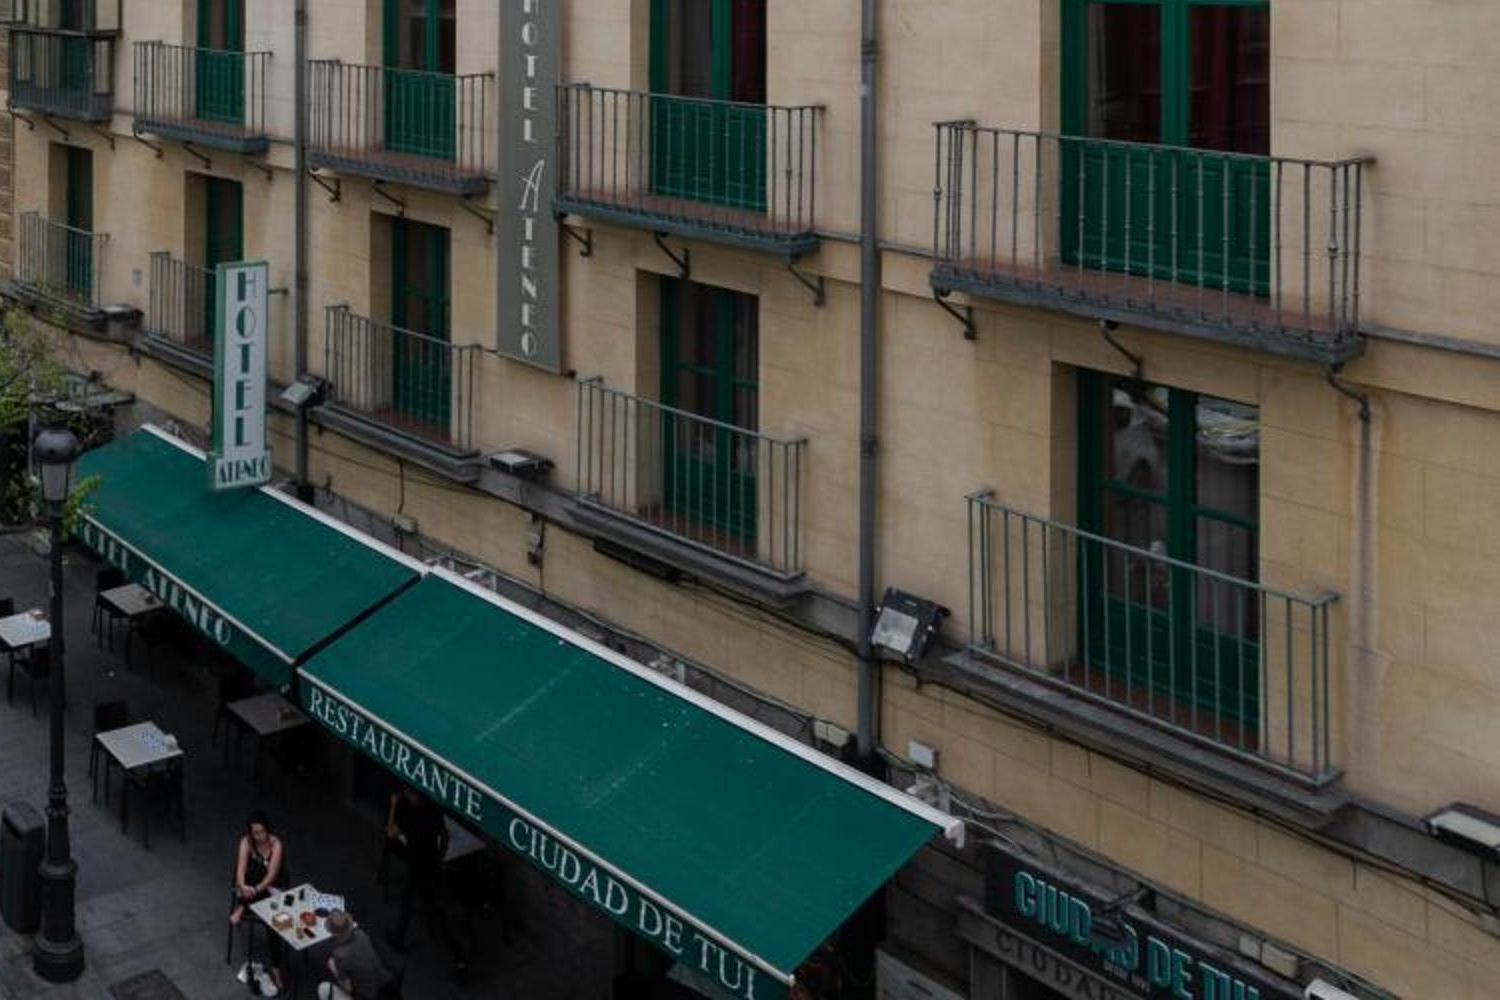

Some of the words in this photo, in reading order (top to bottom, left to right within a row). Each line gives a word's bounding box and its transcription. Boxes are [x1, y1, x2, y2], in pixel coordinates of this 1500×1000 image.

[518, 160, 546, 357] ATENEO
[235, 271, 257, 447] HOTEL
[140, 567, 232, 646] ATENEO
[308, 686, 484, 821] RESTAURANTE
[509, 817, 629, 916] CIUDAD
[638, 898, 684, 955] DE
[693, 934, 758, 1000] TUI
[1146, 935, 1194, 1000] DE
